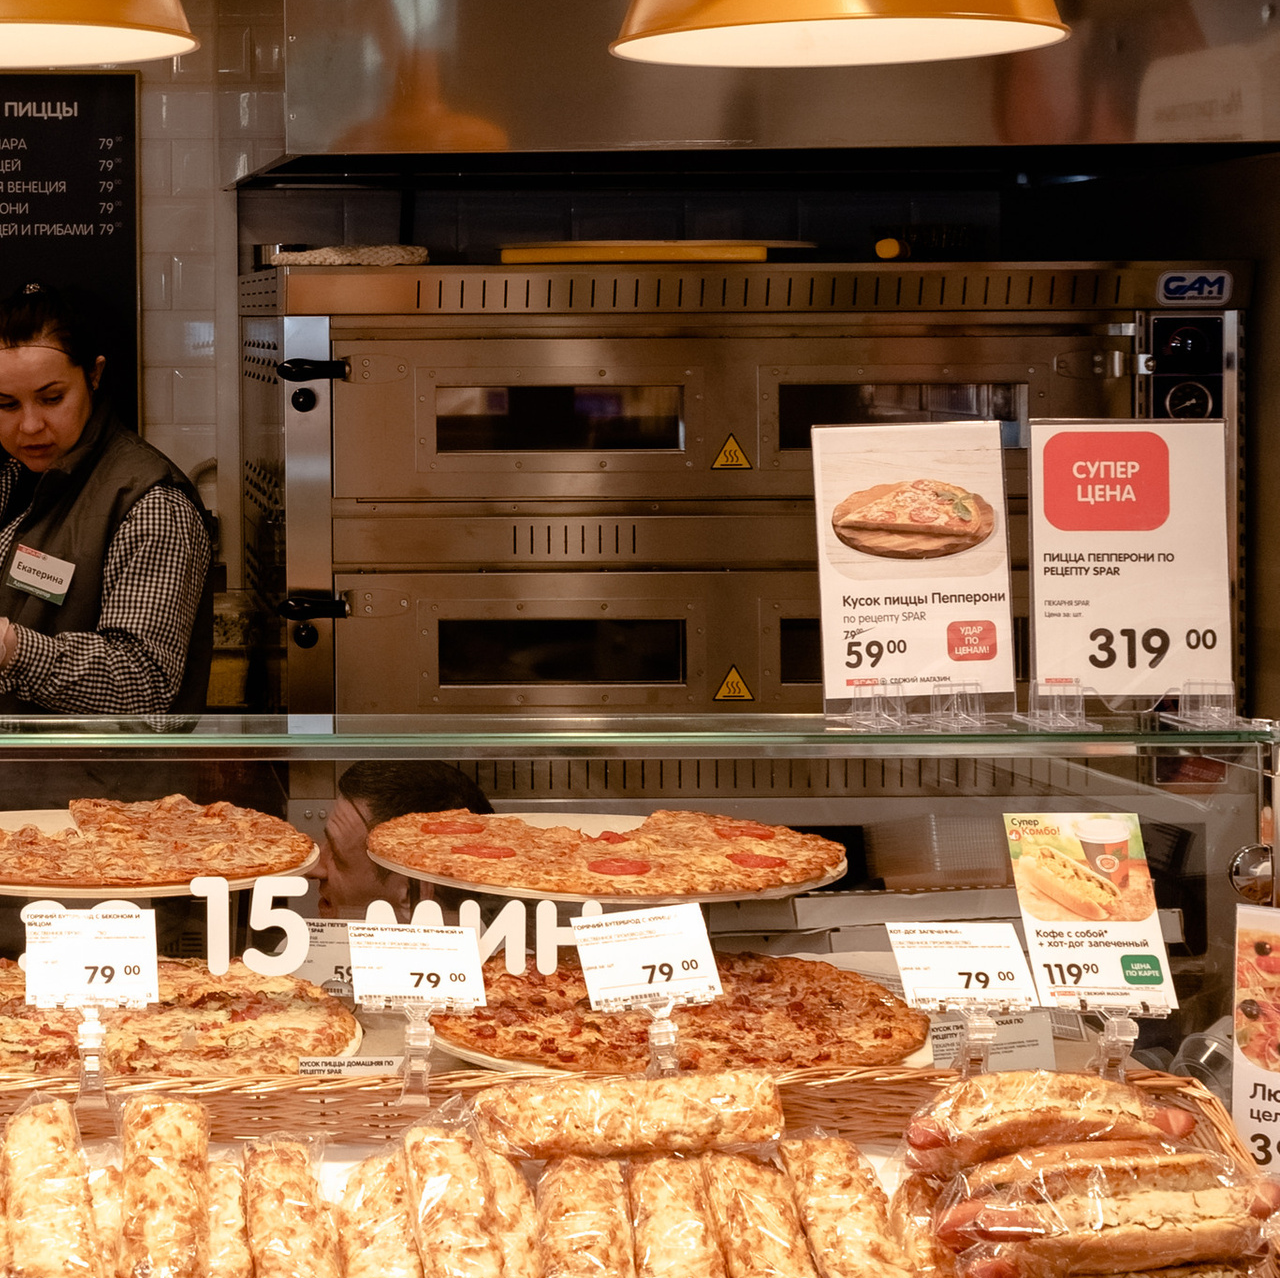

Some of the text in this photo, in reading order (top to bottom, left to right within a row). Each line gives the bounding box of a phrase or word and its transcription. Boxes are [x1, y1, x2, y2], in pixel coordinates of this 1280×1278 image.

[4, 102, 78, 120] ПИЦЦЫ
[8, 182, 66, 194] ВЕНЕЦИЯ
[22, 224, 30, 235] И
[34, 224, 94, 236] ГРИБАМИ
[1164, 276, 1225, 296] GAM
[1072, 461, 1140, 482] СУПЕР
[1076, 484, 1136, 505] ЦЕНА
[1044, 553, 1174, 564] ПИЦЦА ПЕППЕРОНИ ПО
[16, 561, 64, 586] Екатерина
[1044, 566, 1120, 577] РЕЦЕПТУ SPAR
[842, 592, 1006, 609] Кусок пиццы Пепперони
[843, 612, 926, 625] по рецепту SPAR
[960, 626, 984, 636] УДАР
[954, 646, 990, 655] ЦЕНАМ!
[1089, 628, 1218, 669] 319 00
[1011, 818, 1039, 826] Супер
[1021, 826, 1060, 836] Комбо!
[190, 876, 309, 977] 15
[366, 900, 603, 977] ин
[1036, 930, 1064, 939] Кофе
[1048, 940, 1149, 948] хот-дог запеченный
[84, 965, 140, 984] 79 00
[642, 959, 698, 984] 79 00
[410, 972, 466, 988] 79 00
[958, 971, 1014, 989] 79 00
[300, 1060, 320, 1068] КУСОК
[321, 1060, 346, 1068] ПИЦЦЫ
[346, 1060, 384, 1068] ДОМАШНЯЯ
